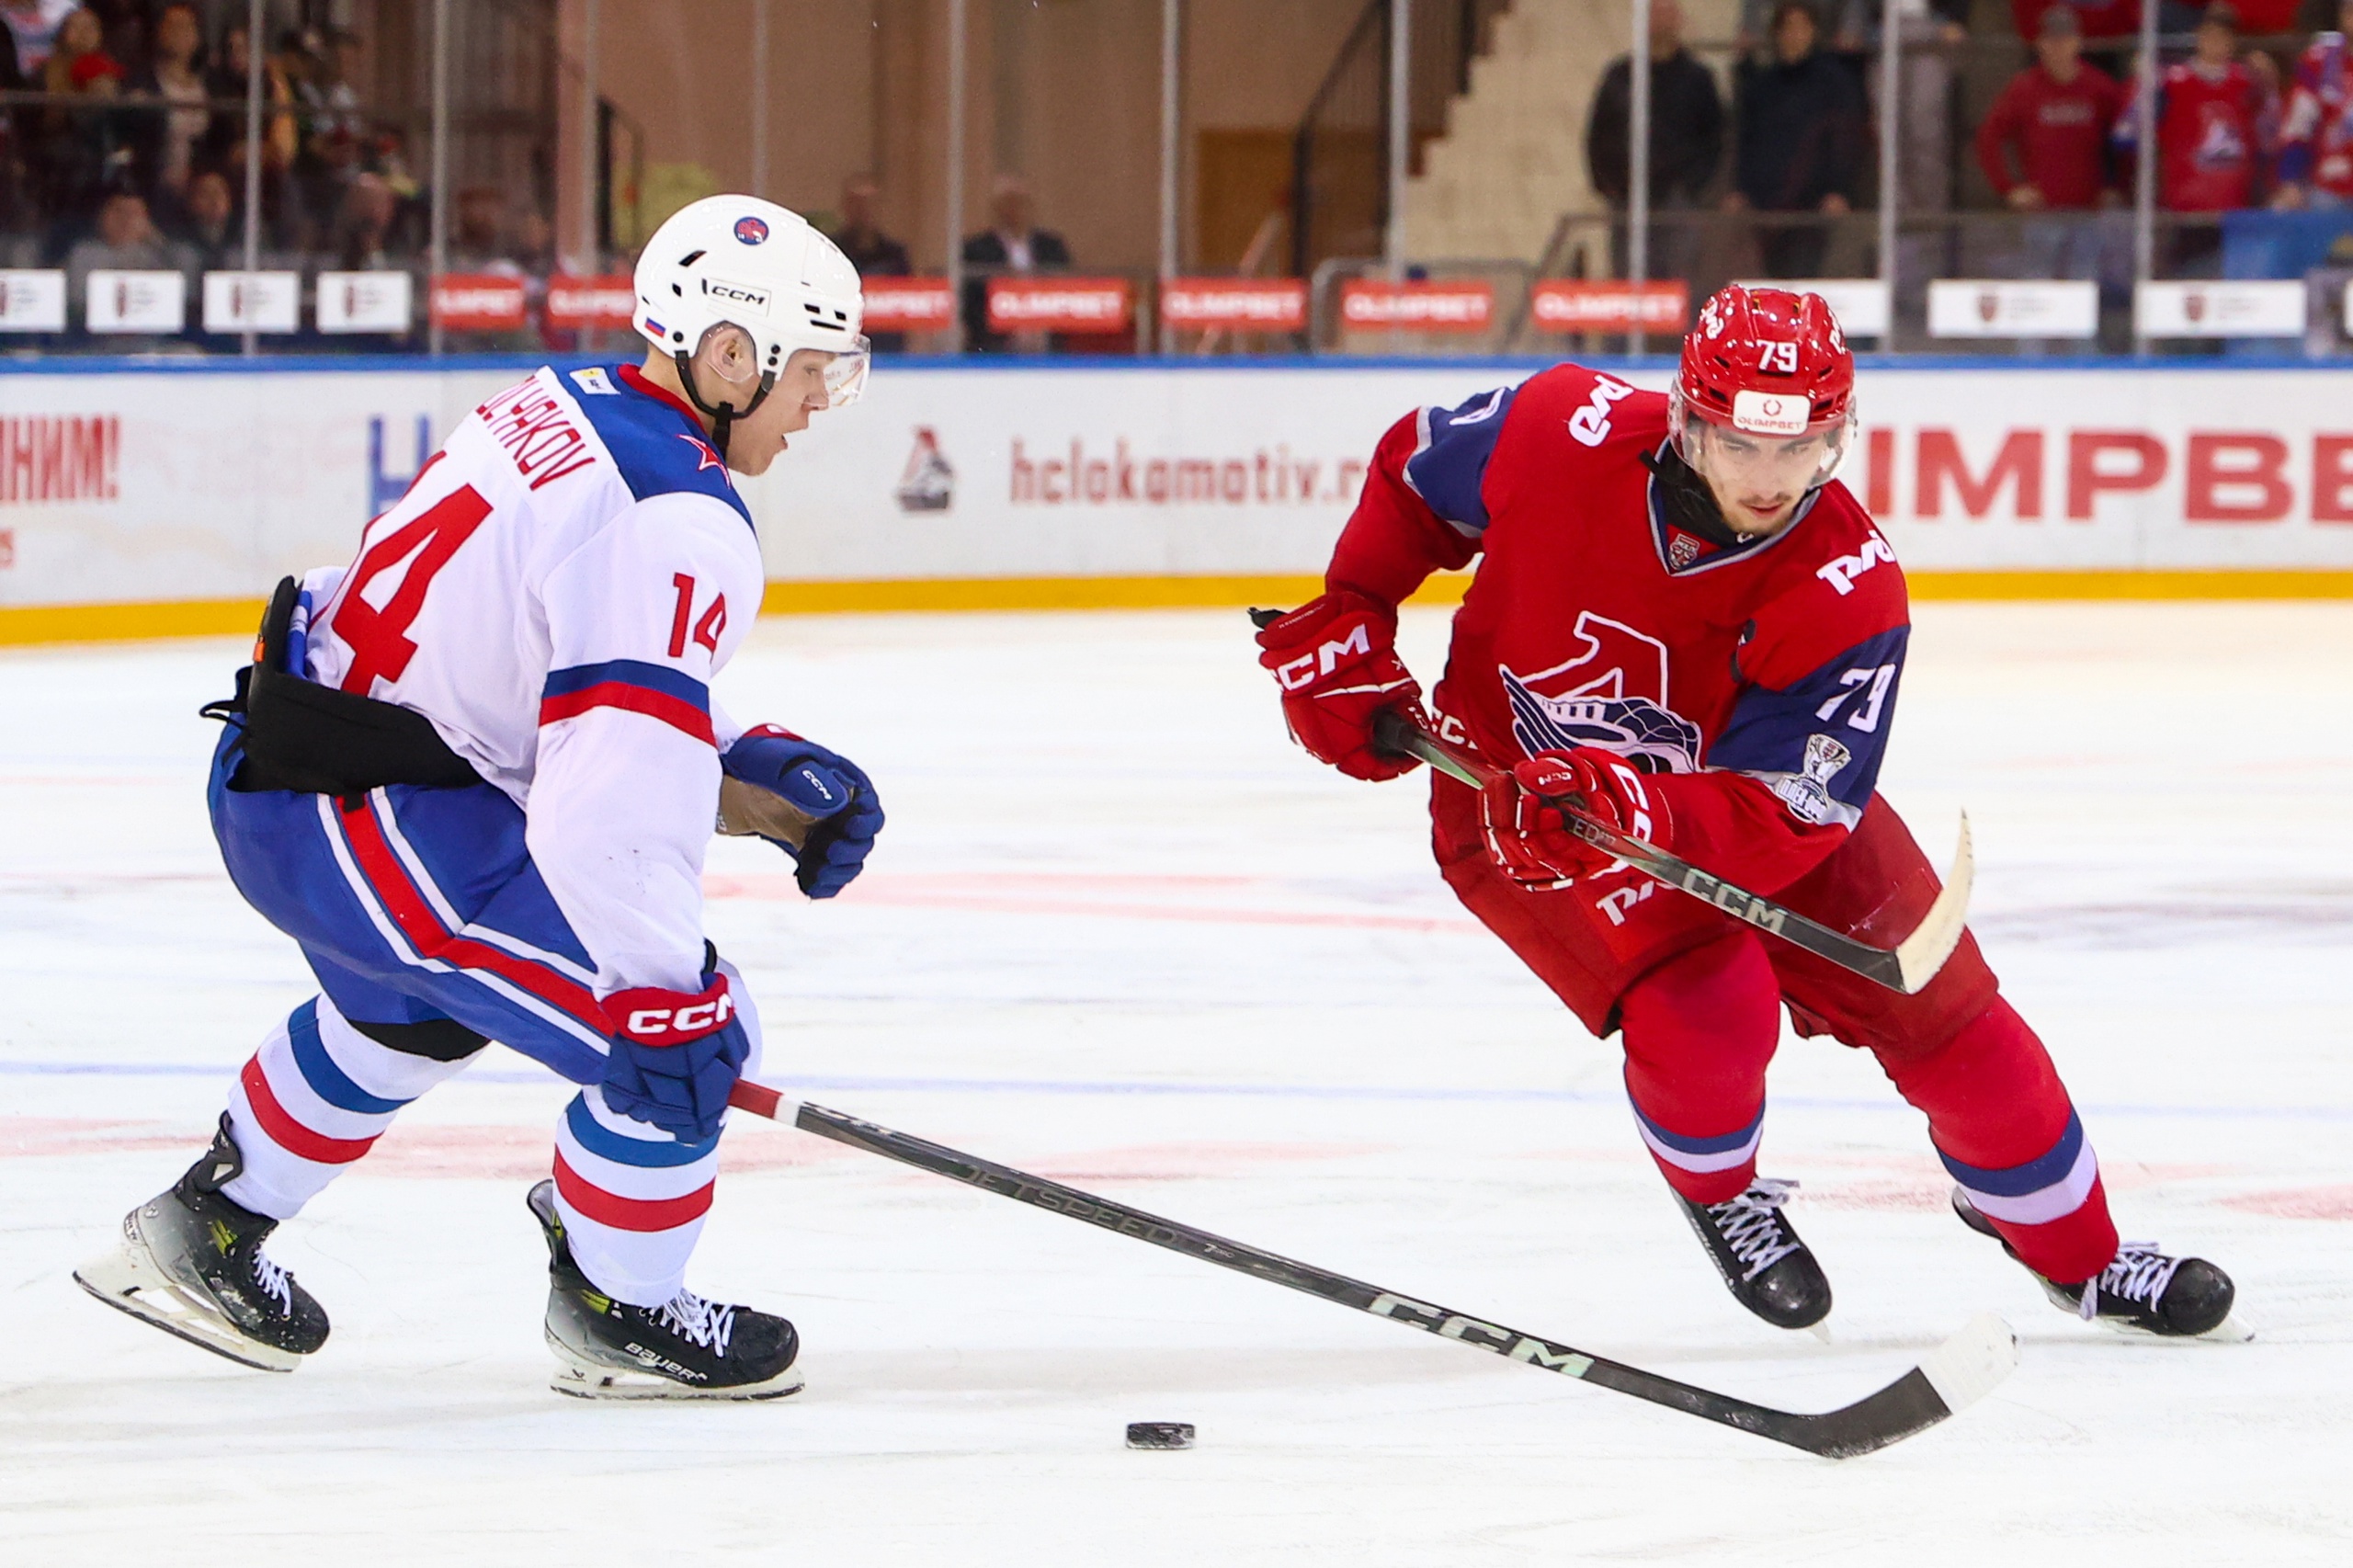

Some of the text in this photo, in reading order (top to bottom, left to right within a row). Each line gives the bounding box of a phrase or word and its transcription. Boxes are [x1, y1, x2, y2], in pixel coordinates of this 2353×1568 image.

[711, 285, 766, 305] CCM
[1756, 338, 1798, 373] 79
[1737, 416, 1803, 430] OLIMPBET
[0, 416, 120, 502] НИМ!
[667, 572, 727, 664] 14
[1271, 623, 1370, 691] CM
[1814, 663, 1896, 733] 79
[801, 769, 833, 801] CCM
[1682, 867, 1789, 933] CCM
[968, 1165, 1178, 1244] JETSPEED
[1368, 1292, 1597, 1380] CCM
